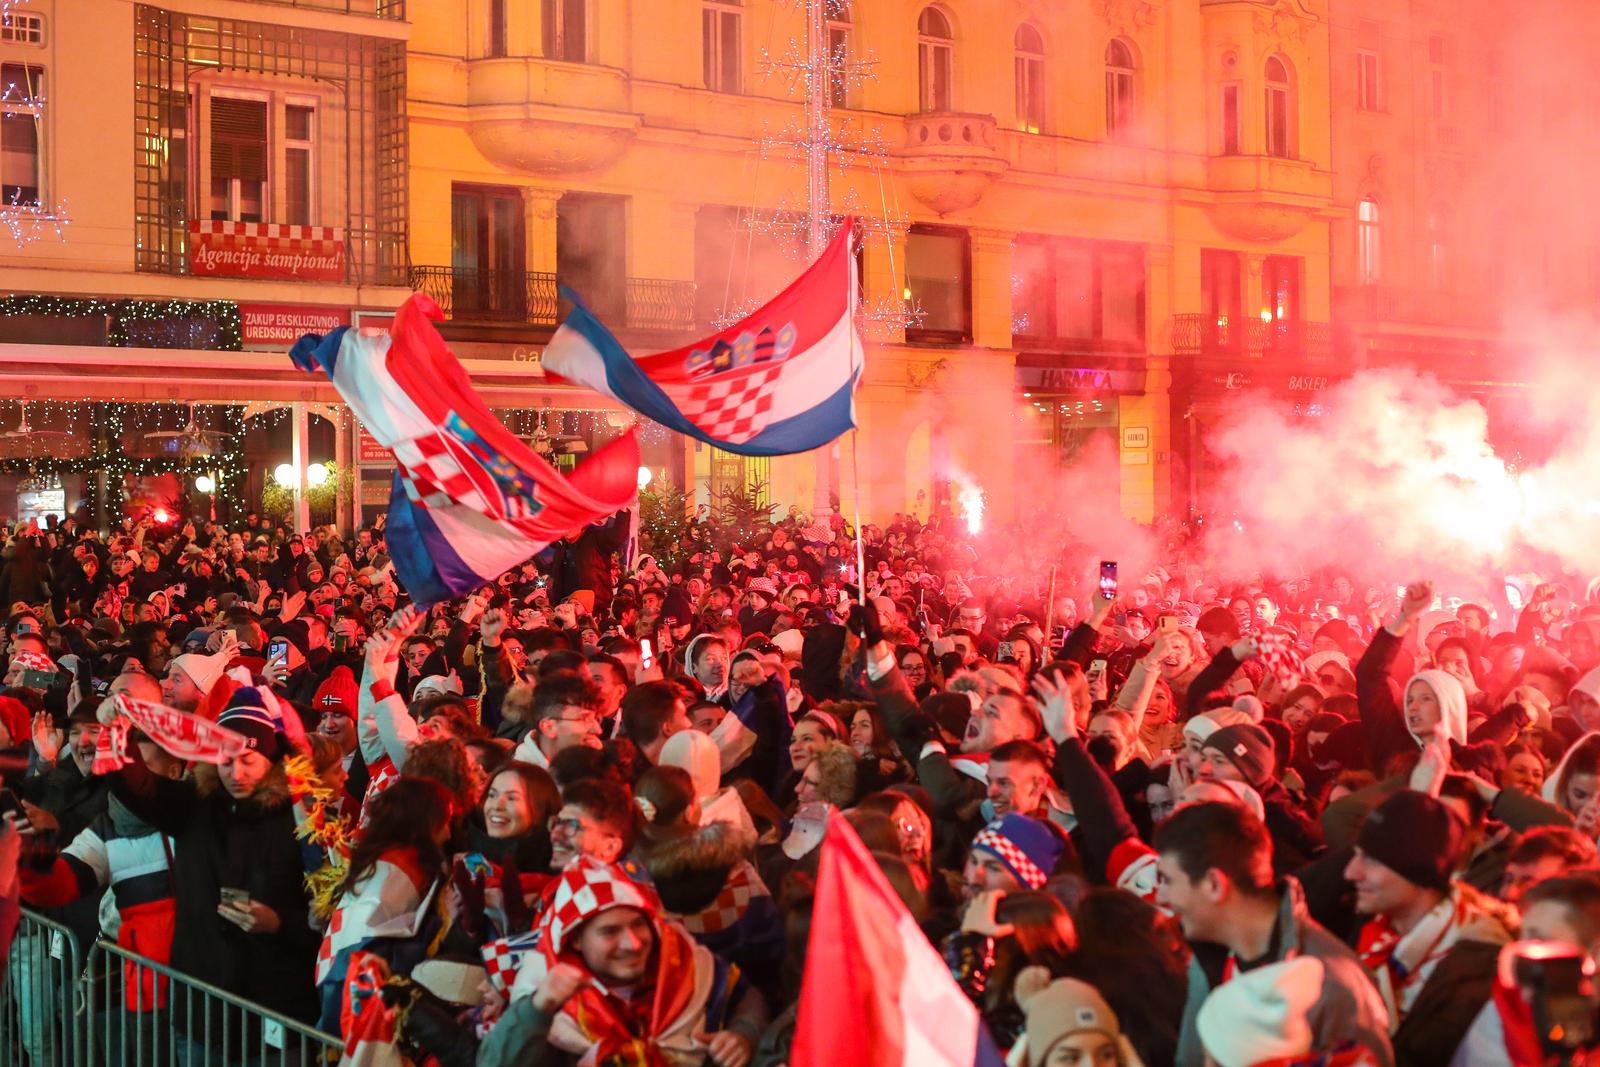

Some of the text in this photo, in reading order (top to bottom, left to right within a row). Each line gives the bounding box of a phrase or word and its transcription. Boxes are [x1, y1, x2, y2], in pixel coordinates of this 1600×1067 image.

[195, 243, 340, 273] Agencija šampiona!
[245, 313, 339, 328] ZAKUP EKSKLUZIVNOG
[246, 327, 293, 339] UREDSKOG
[1288, 375, 1327, 391] BASLER
